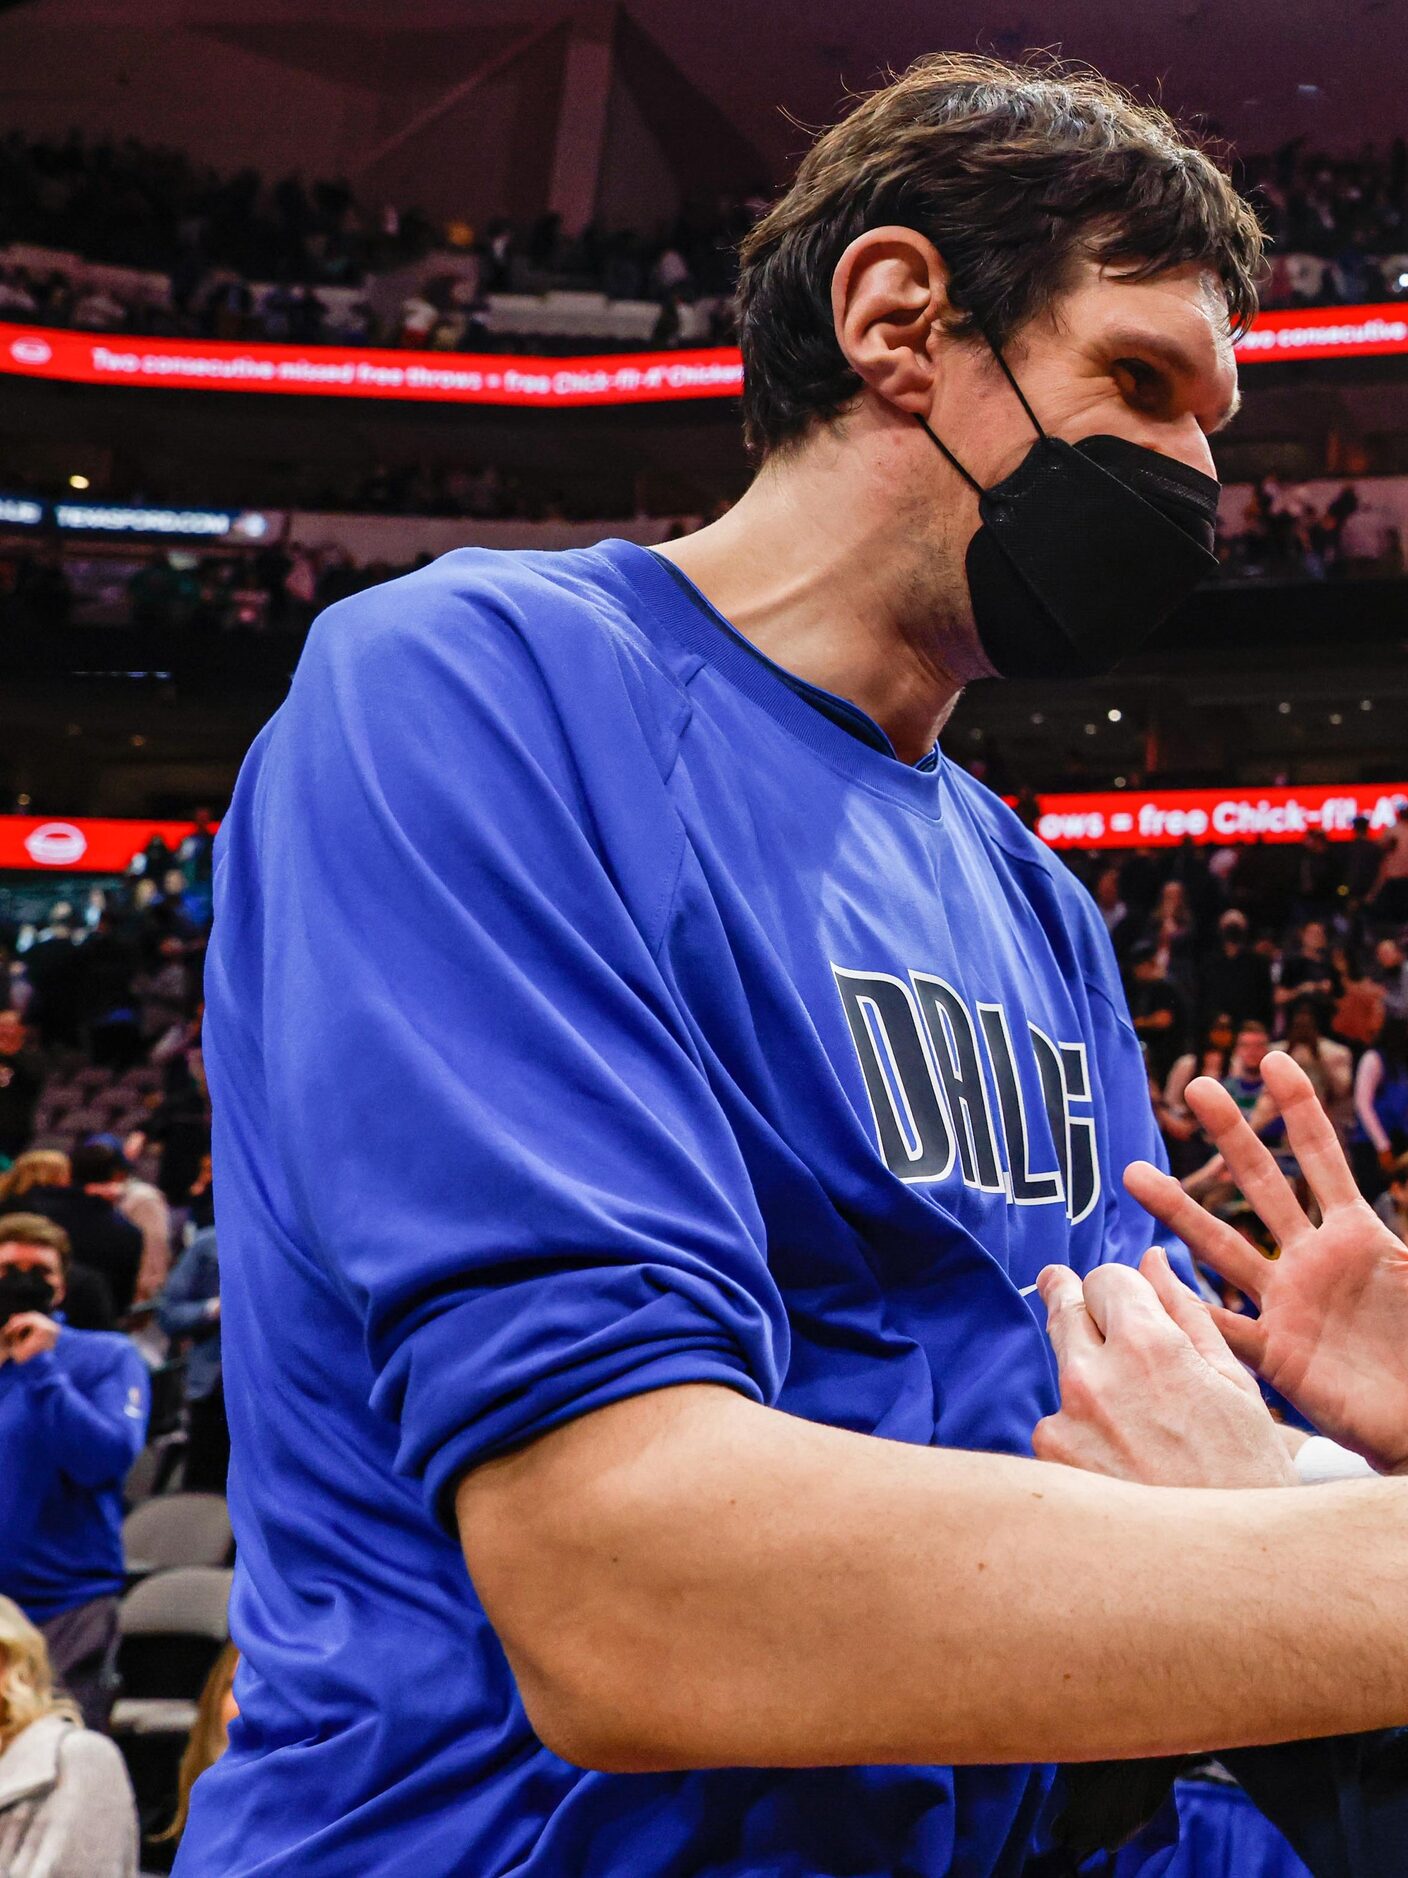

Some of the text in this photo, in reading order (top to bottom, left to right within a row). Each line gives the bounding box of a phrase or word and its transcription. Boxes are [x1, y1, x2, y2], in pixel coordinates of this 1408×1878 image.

[1237, 328, 1276, 350] wo
[1038, 812, 1104, 839] ows
[1138, 803, 1208, 836] free
